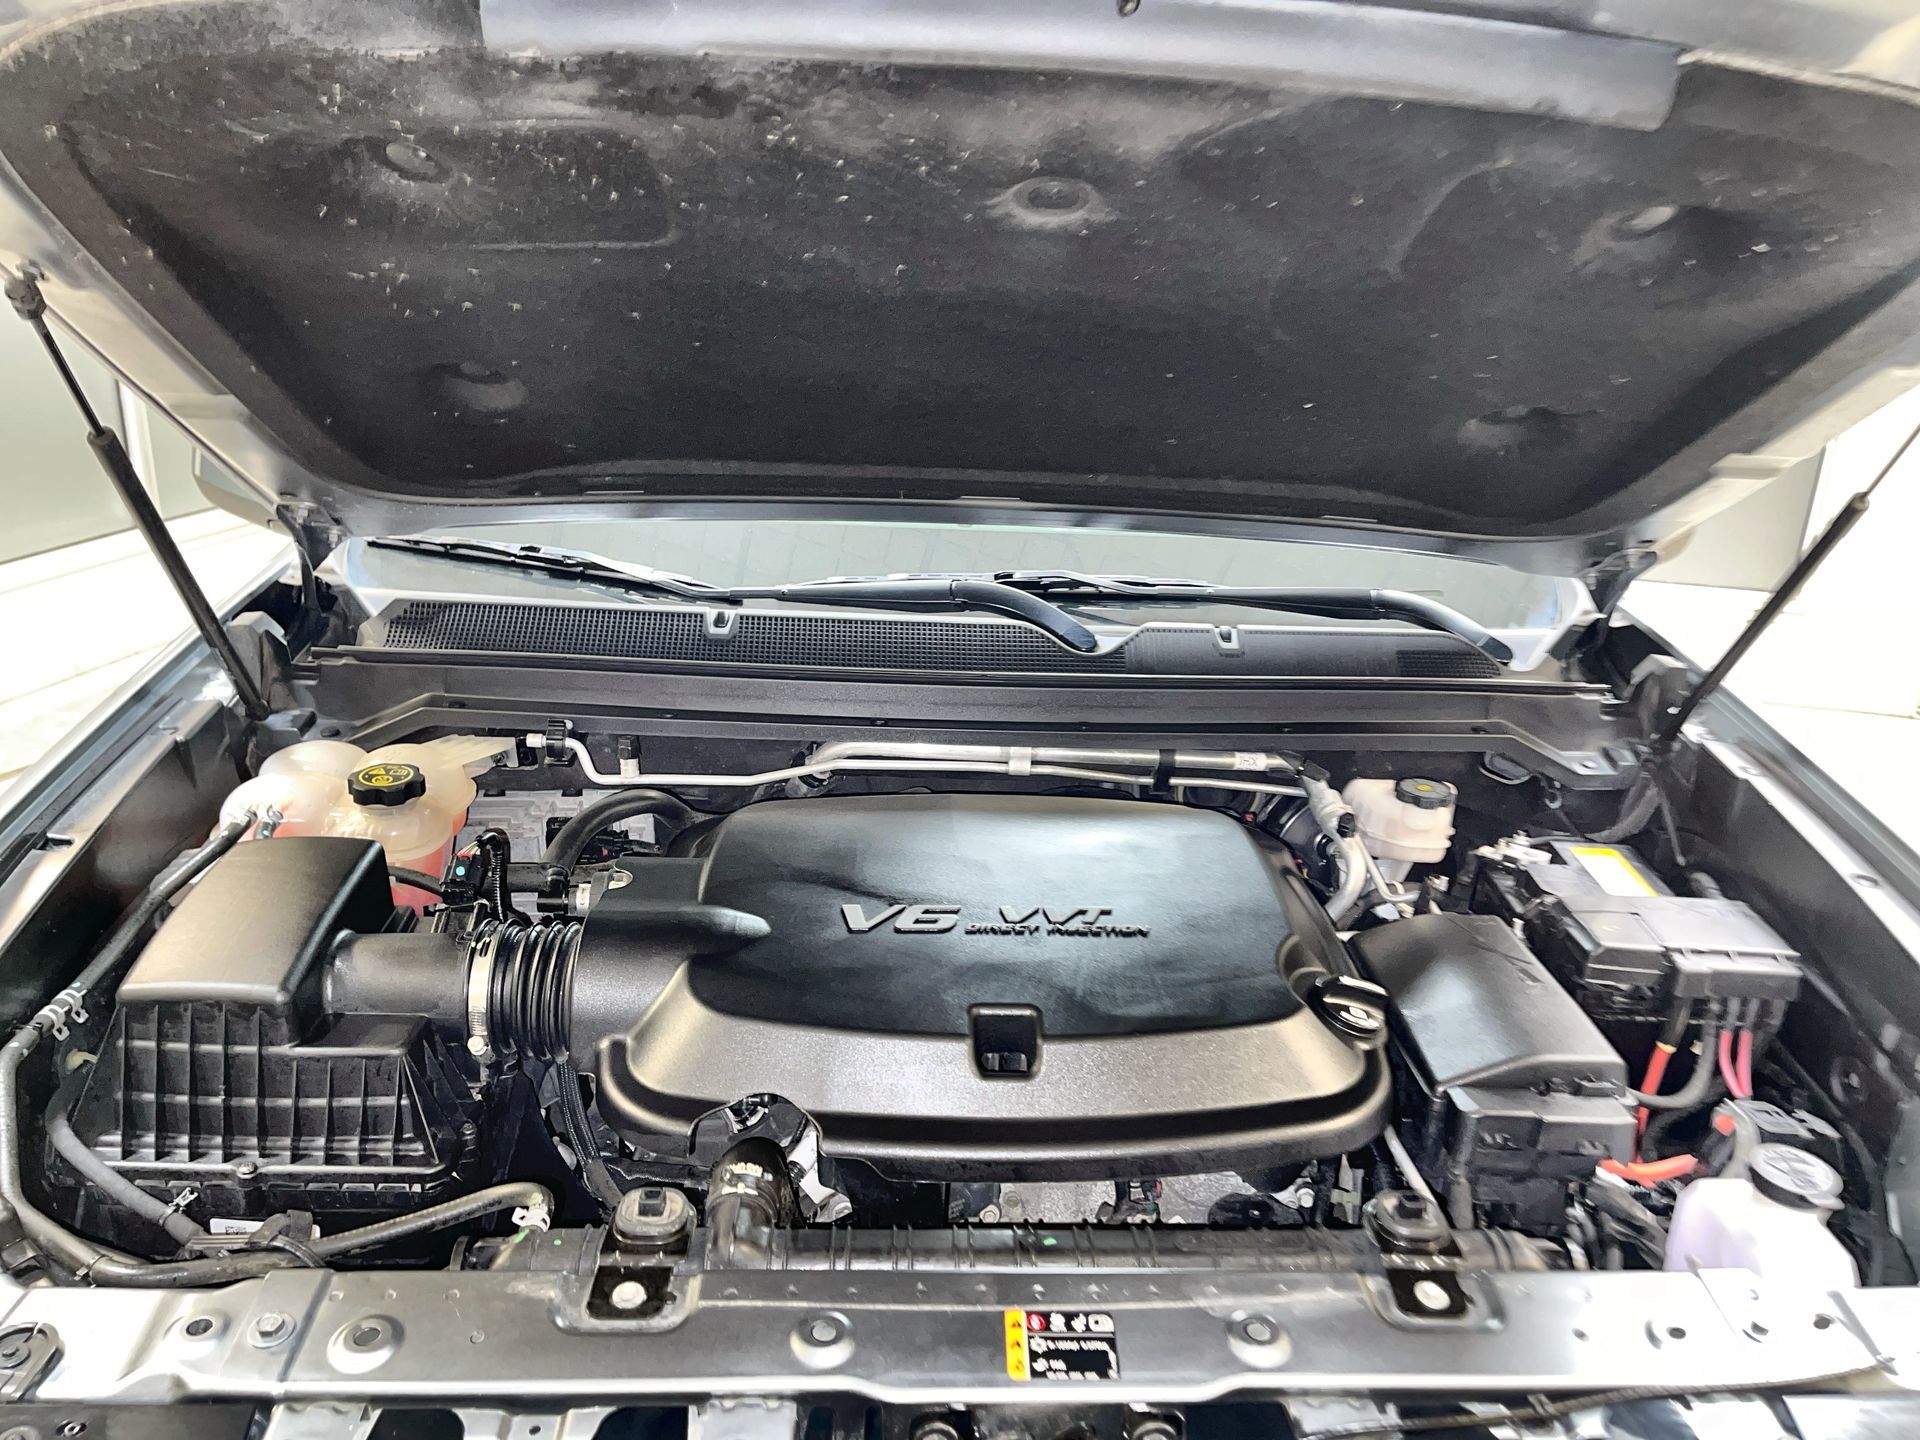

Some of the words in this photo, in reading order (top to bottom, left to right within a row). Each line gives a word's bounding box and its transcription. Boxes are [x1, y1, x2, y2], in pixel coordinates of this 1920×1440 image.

[840, 903, 961, 934] V6
[998, 904, 1114, 925] VVT
[964, 923, 1040, 936] DIRECT
[1046, 923, 1152, 938] INJECTION
